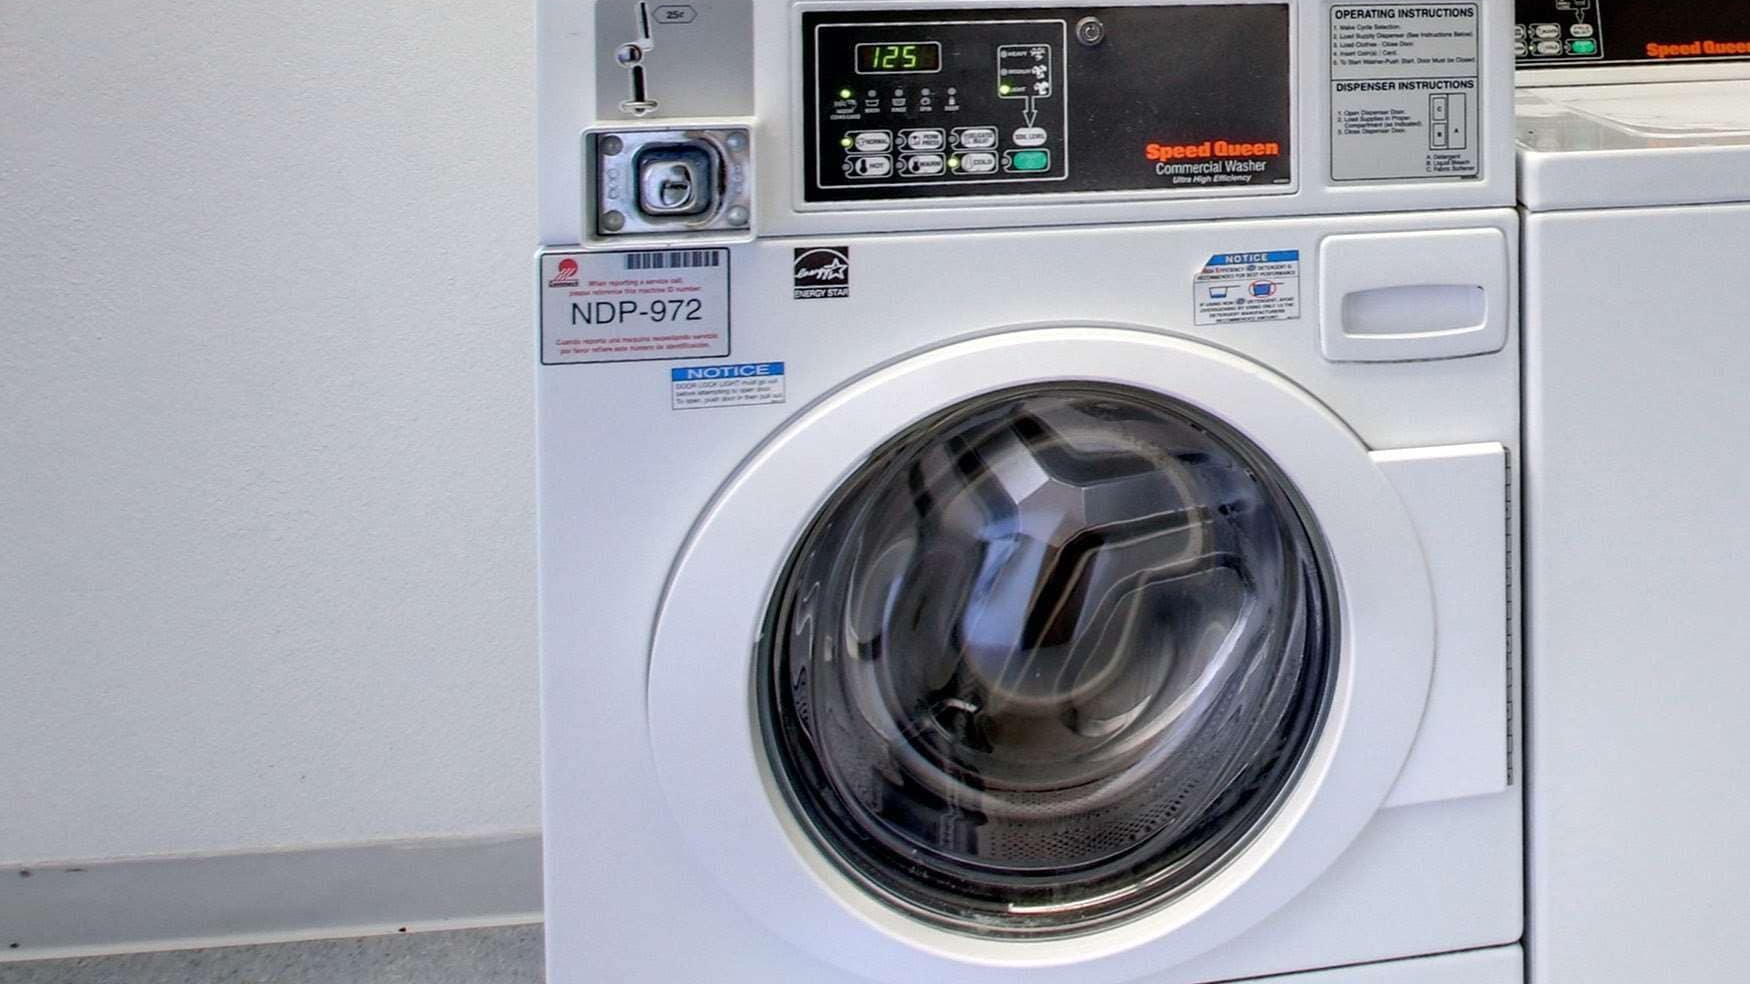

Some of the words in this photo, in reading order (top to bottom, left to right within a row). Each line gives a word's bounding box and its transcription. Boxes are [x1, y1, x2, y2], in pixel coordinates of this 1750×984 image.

[1335, 9, 1395, 19] OPERATING
[1398, 8, 1474, 18] INSTRUCTIONS
[873, 46, 916, 68] 125
[1647, 42, 1700, 58] Speed
[1336, 82, 1395, 92] DISPENSER
[1398, 80, 1474, 90] INSTRUCTIONS
[1146, 142, 1211, 162] Speed
[1214, 141, 1280, 156] Queen
[1156, 161, 1222, 175] Commercial
[1225, 160, 1266, 171] Washer
[1173, 176, 1191, 184] Ultra
[1193, 176, 1212, 184] High
[1213, 174, 1252, 182] Efficiency
[1225, 254, 1268, 263] NOTICE
[794, 289, 826, 298] ENERGY
[827, 288, 849, 297] STAR
[572, 298, 702, 325] NDP-972
[687, 364, 769, 378] NOTICE
